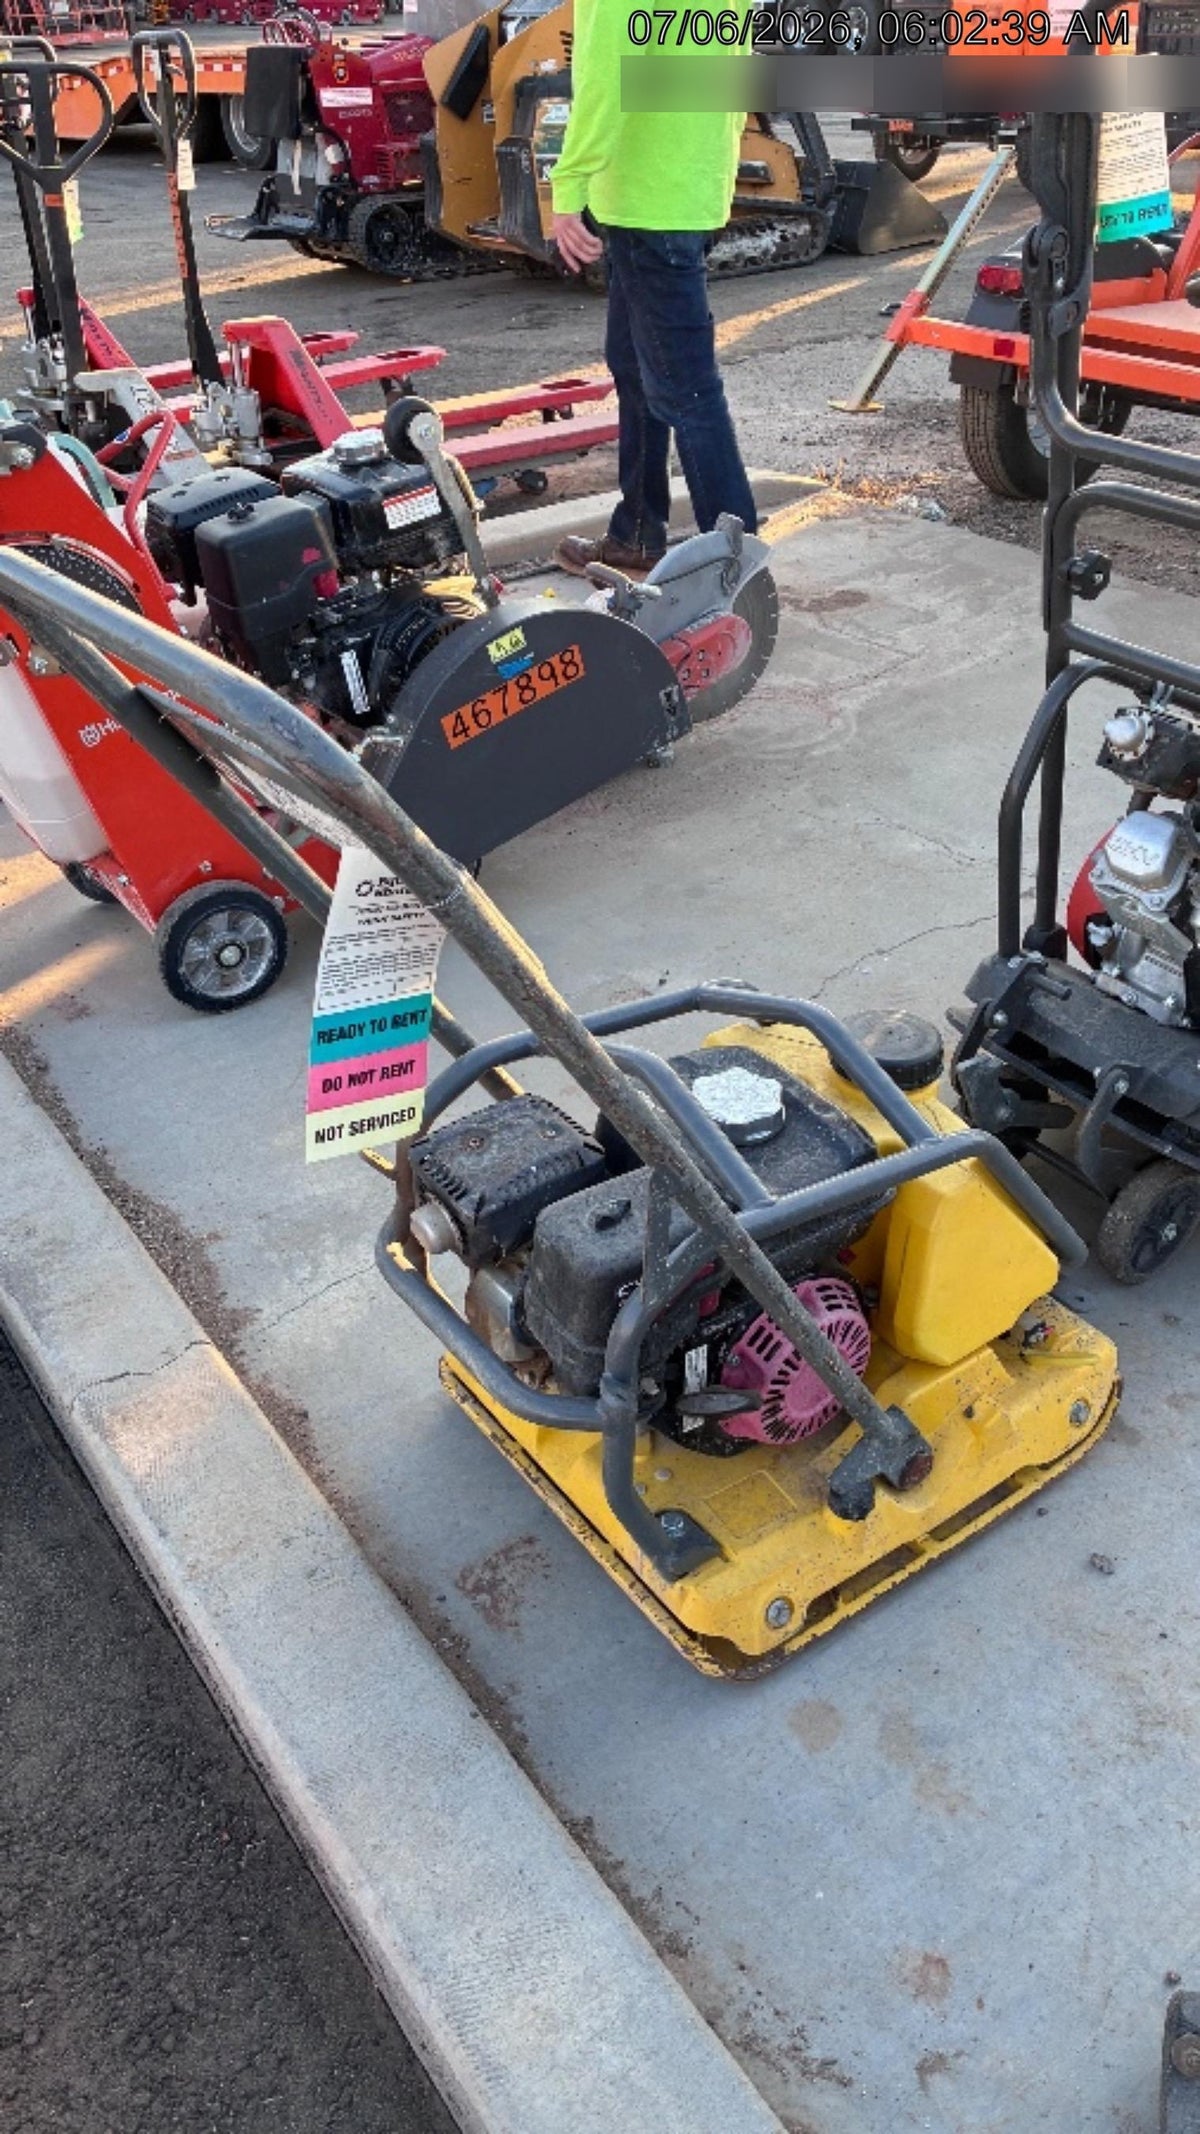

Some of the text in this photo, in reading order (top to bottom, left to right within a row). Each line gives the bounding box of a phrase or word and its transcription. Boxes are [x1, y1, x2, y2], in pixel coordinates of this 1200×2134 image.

[452, 649, 579, 739] 467898
[316, 1007, 428, 1046] READY TO RENT
[321, 1059, 416, 1095] DO NOT RENT
[314, 1106, 416, 1145] NOT SERVICED
